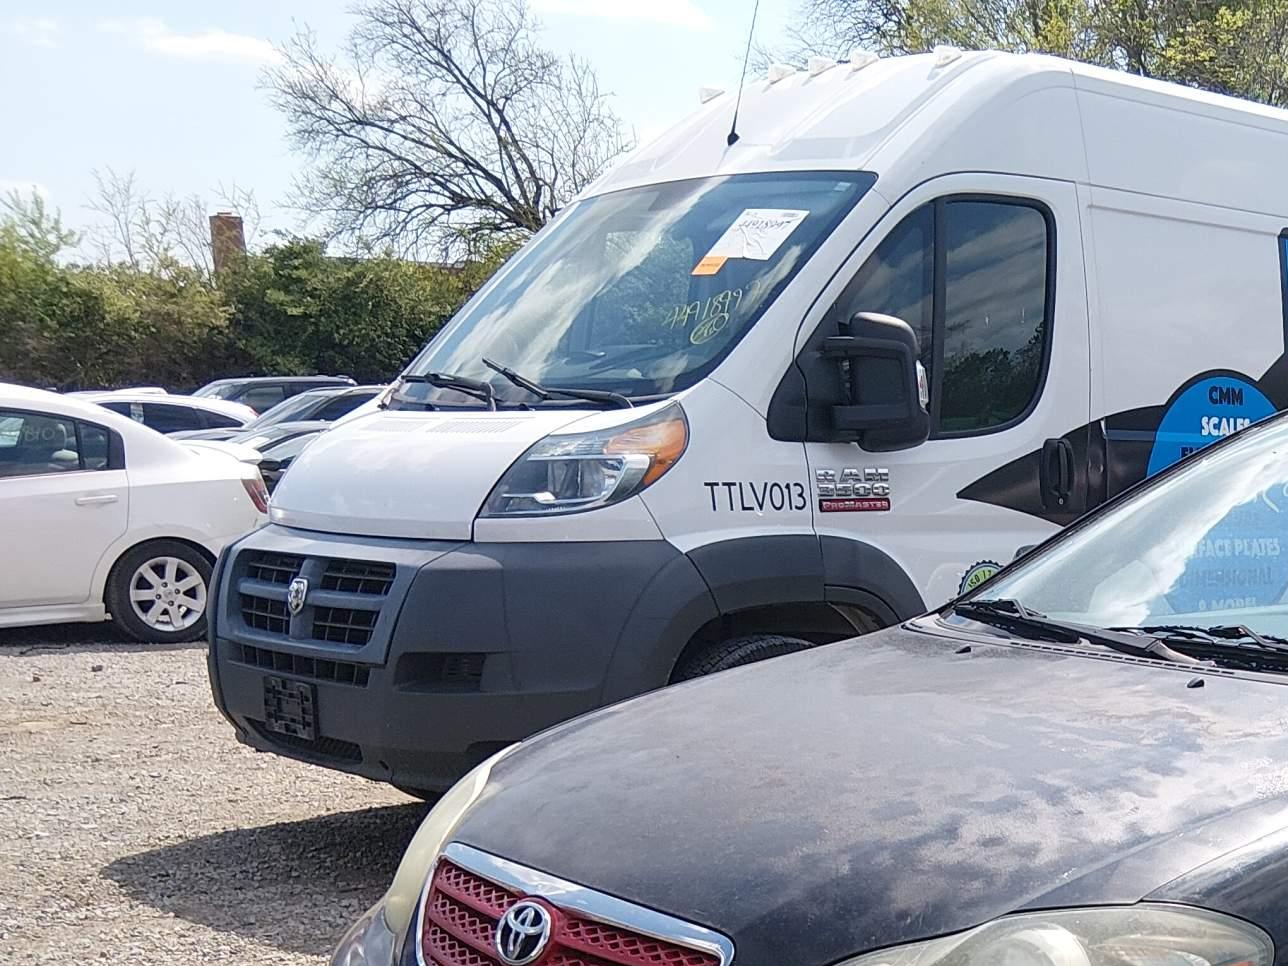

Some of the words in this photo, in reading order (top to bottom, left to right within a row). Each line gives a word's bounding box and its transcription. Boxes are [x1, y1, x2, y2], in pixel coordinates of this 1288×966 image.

[1208, 386, 1245, 407] CMM
[815, 468, 889, 483] RAM
[704, 481, 807, 512] TTLV013
